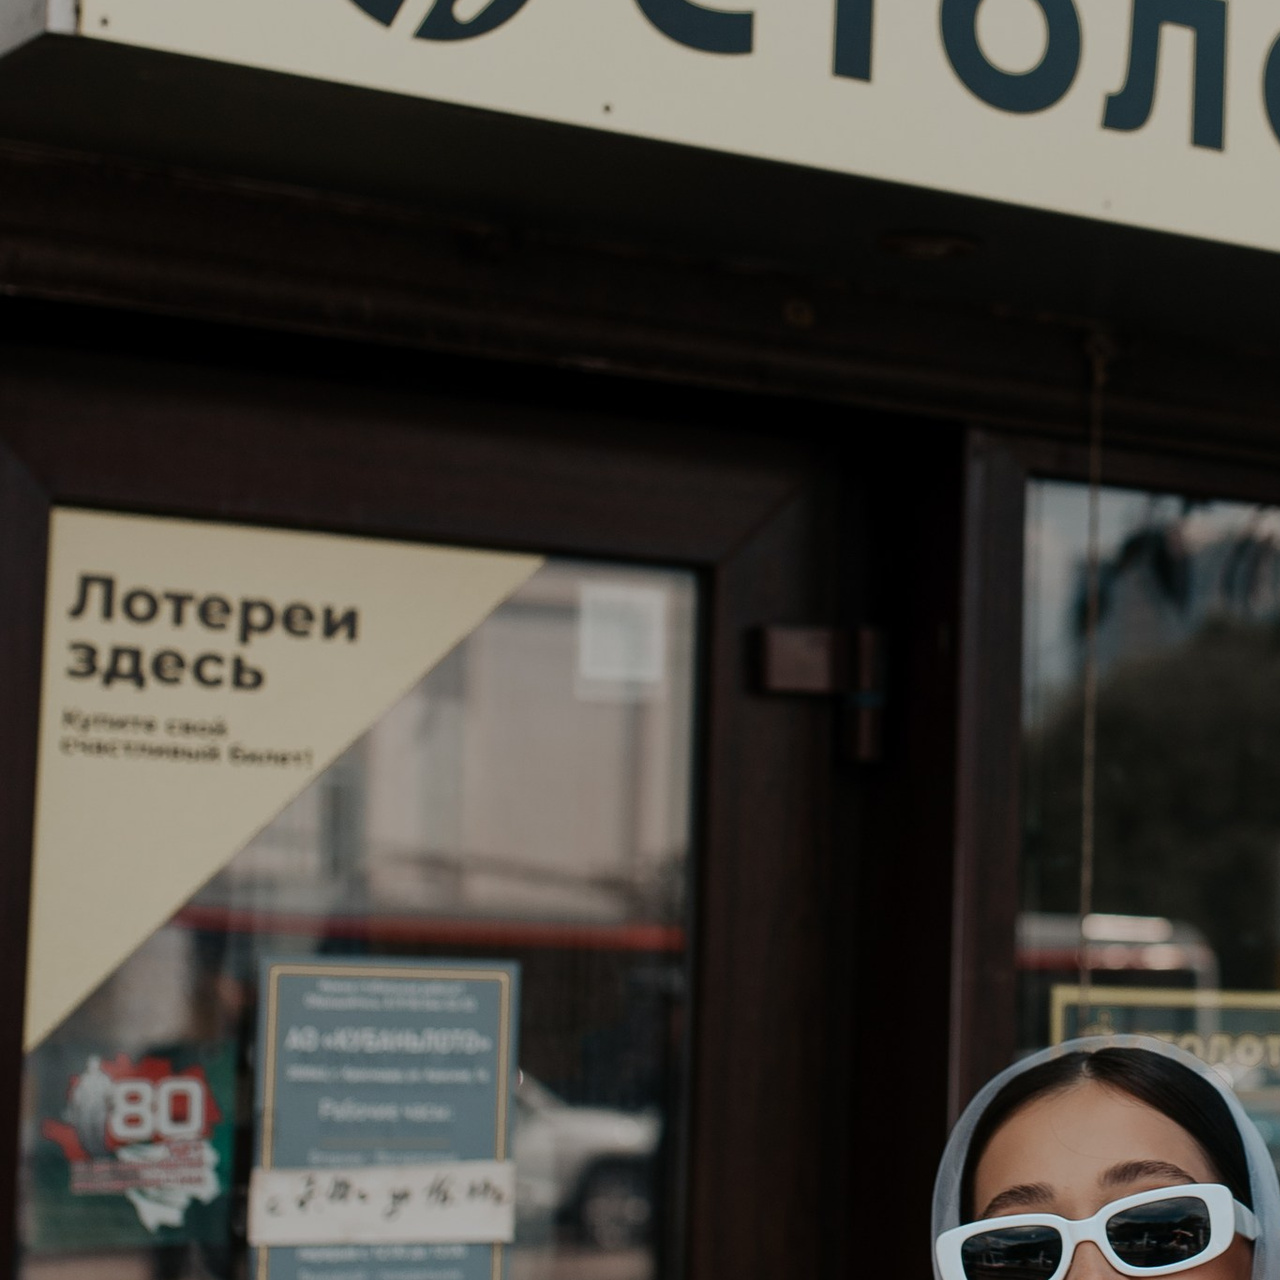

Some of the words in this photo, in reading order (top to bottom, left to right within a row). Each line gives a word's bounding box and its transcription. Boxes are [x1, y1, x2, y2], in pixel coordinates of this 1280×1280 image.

[68, 573, 360, 645] Лотереи
[66, 639, 265, 693] здесь
[111, 1077, 205, 1141] 80
